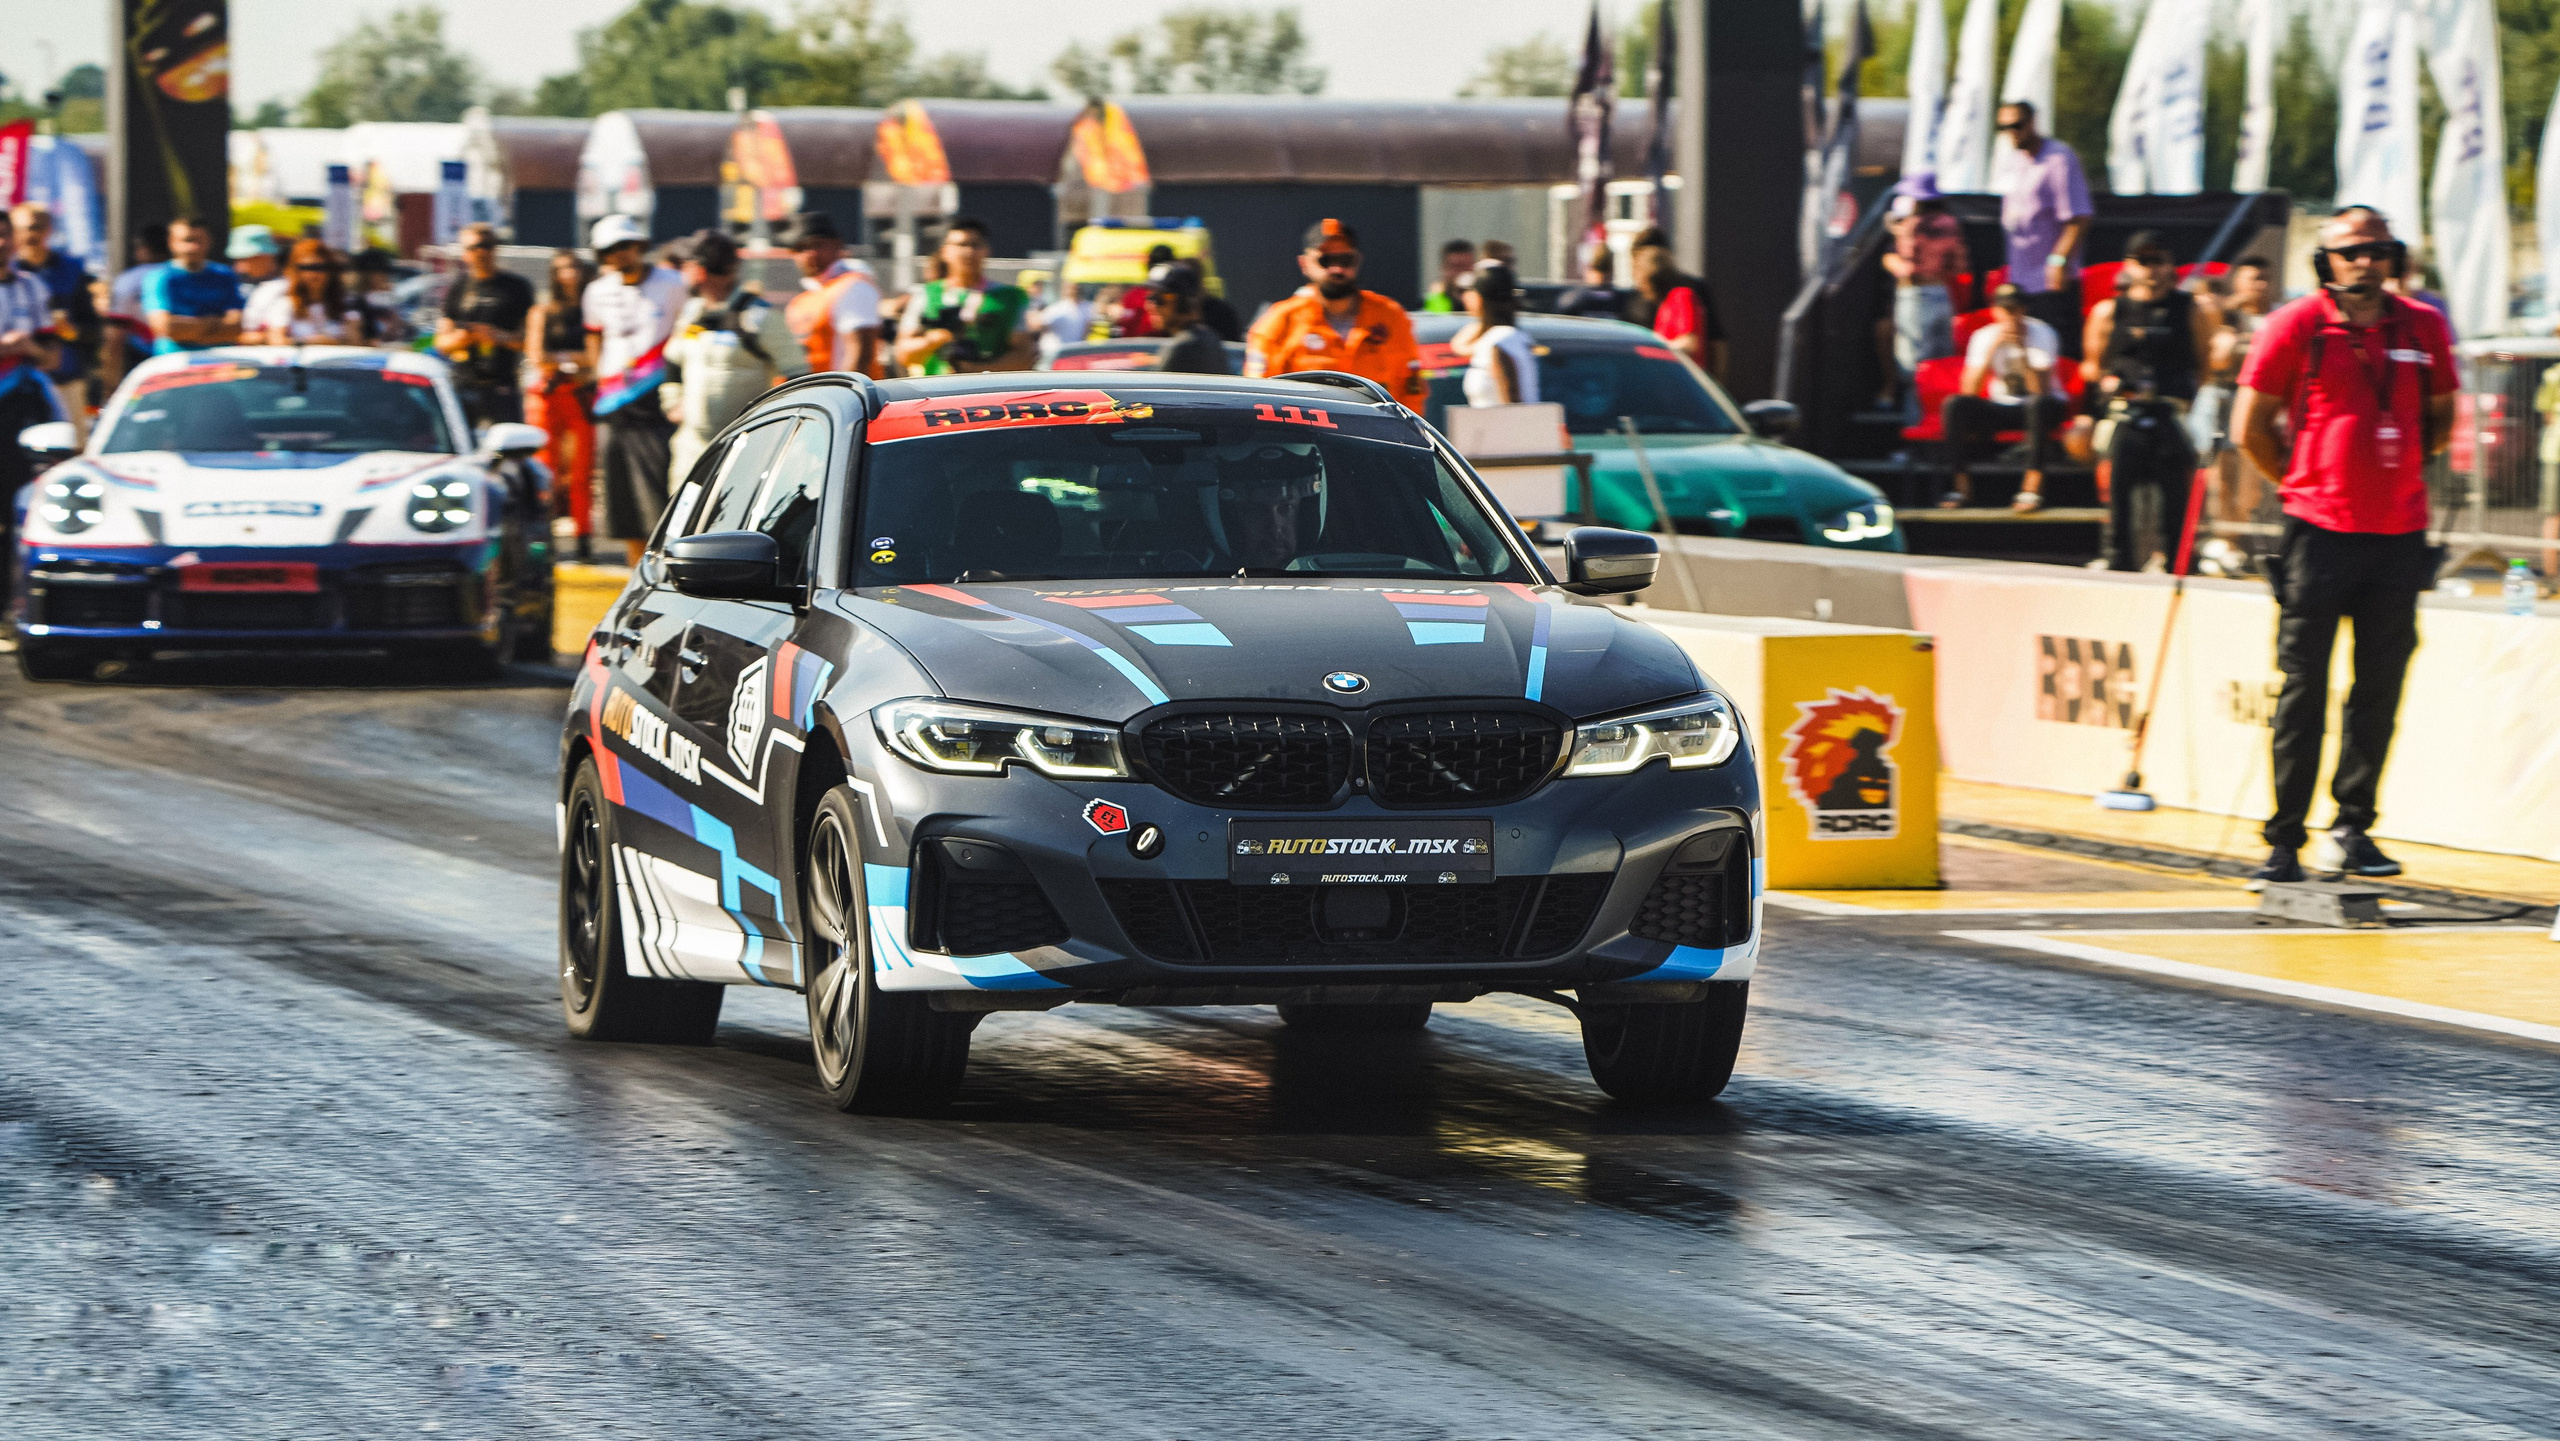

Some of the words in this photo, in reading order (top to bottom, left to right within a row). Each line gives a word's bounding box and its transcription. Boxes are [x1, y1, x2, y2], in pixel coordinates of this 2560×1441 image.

[923, 401, 1090, 427] RDRC
[1254, 403, 1338, 429] 111
[1267, 839, 1459, 855] AUTOSTOCK_MSK
[1321, 874, 1408, 883] AUTOSTOCK_MSK
